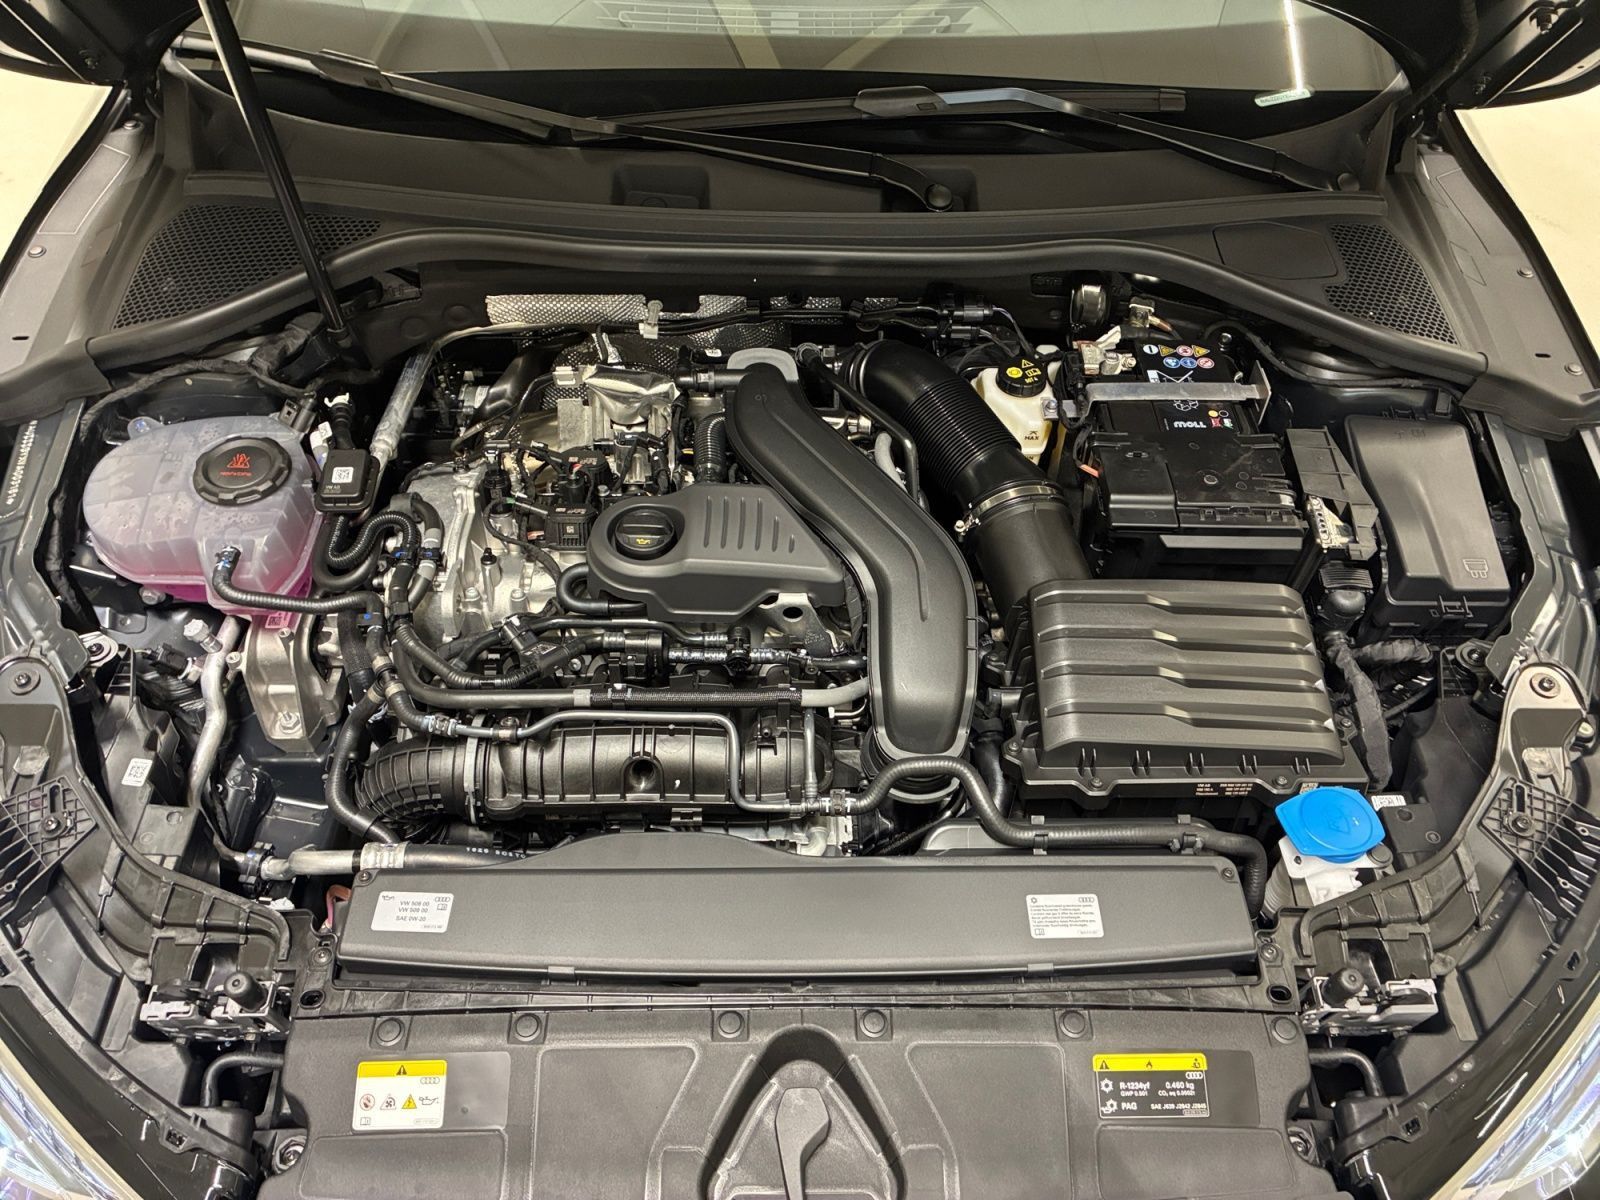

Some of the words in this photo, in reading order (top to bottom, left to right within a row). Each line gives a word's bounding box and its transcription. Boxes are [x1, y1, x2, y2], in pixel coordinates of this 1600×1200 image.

[1119, 1082, 1150, 1090] R-1234yf
[1186, 1082, 1195, 1090] kg
[1121, 1102, 1138, 1110] PAG
